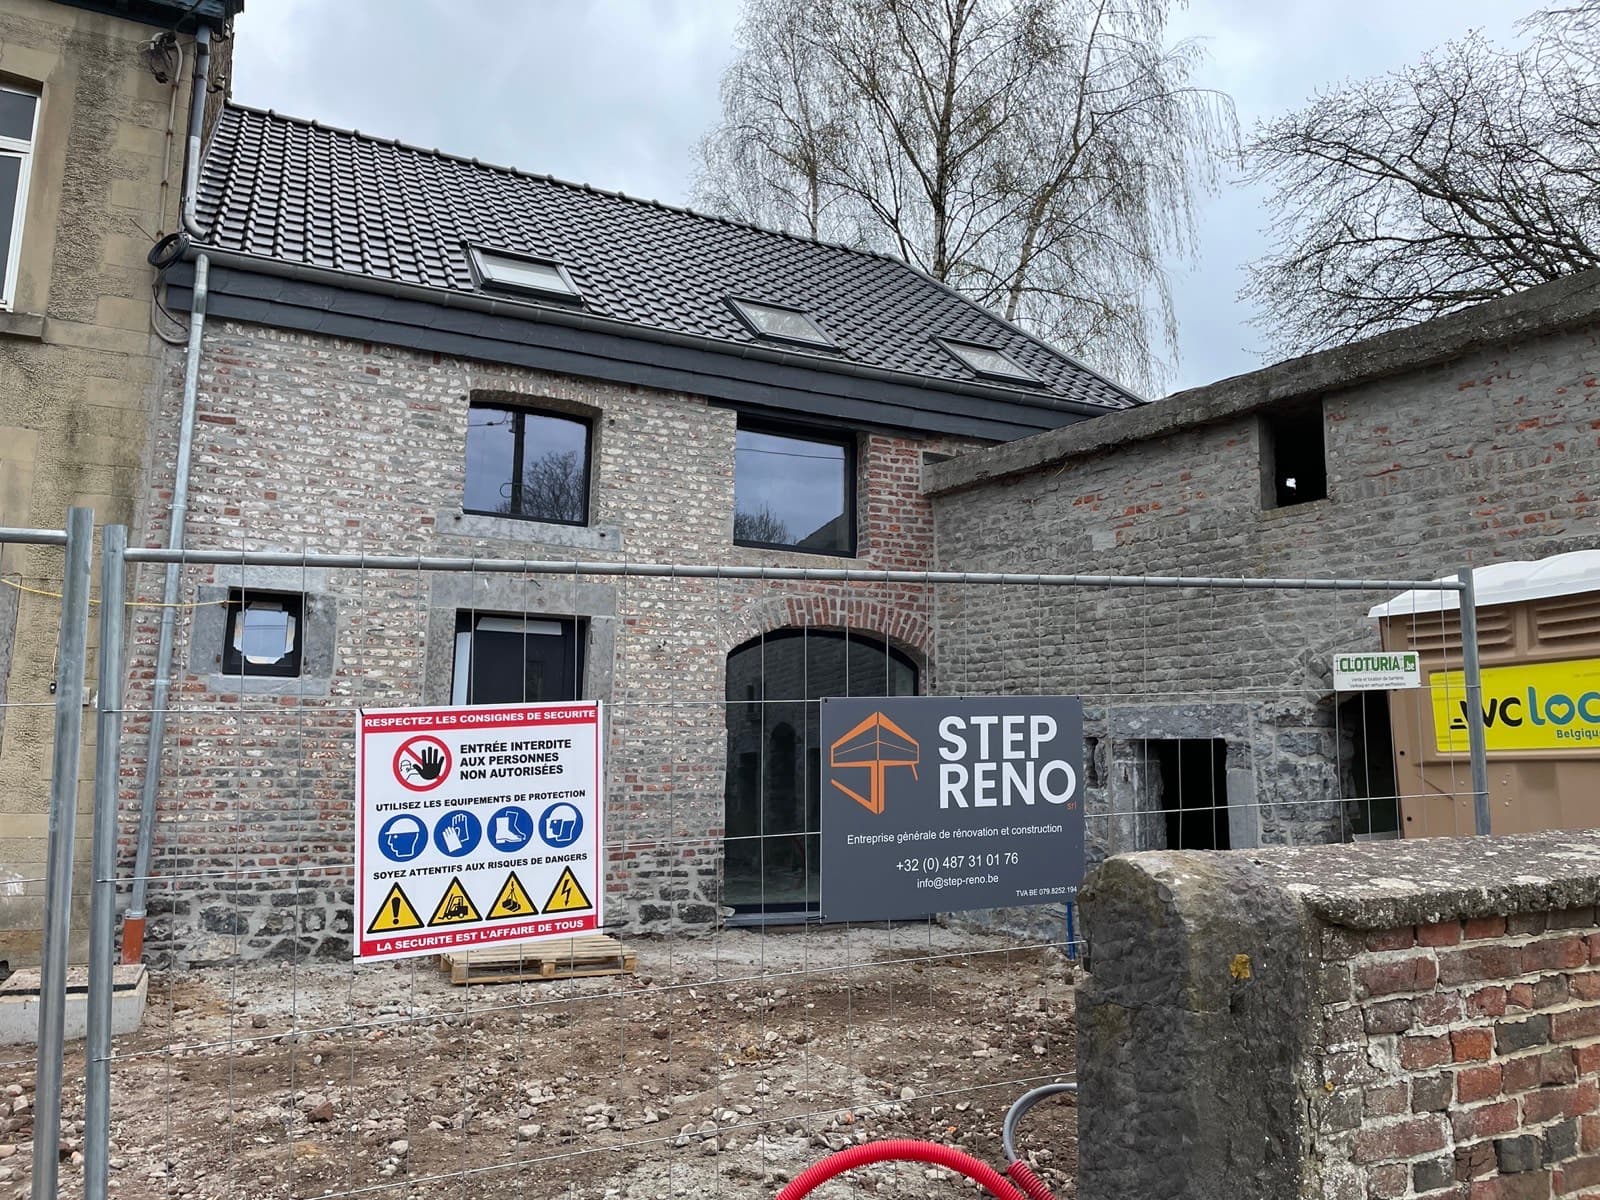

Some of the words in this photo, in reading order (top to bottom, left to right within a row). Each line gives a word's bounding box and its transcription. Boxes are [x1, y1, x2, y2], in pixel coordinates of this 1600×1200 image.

[1339, 656, 1401, 672] CLOTURIA
[365, 716, 433, 728] RESPECTEZ
[435, 714, 457, 725] LES
[459, 712, 524, 724] CONSIGNES
[526, 711, 542, 721] DE
[543, 709, 596, 720] SECURITE
[938, 715, 1058, 761] STEP
[1556, 728, 1600, 741] Belgiqu
[460, 740, 508, 754] ENTRÉE
[510, 739, 572, 751] INTERDITE
[460, 756, 485, 767] AUX
[488, 752, 559, 766] PERSONNES
[460, 769, 487, 780] NON
[490, 764, 563, 778] AUTORISÉES
[939, 760, 1077, 809] RENO
[376, 802, 421, 812] UTILISEZ
[423, 799, 442, 809] LES
[444, 794, 512, 807] EQUIPEMENTS
[514, 792, 527, 802] DE
[528, 789, 586, 801] PROTECTION
[847, 833, 895, 846] Entreprise
[896, 830, 937, 844] générale
[939, 829, 951, 839] de
[952, 826, 999, 839] rénovation
[1000, 826, 1010, 836] et
[1011, 824, 1062, 836] construction
[373, 870, 407, 880] SOYEZ
[409, 864, 463, 877] ATTENTIFS
[465, 862, 485, 872] AUX
[487, 858, 528, 870] RISQUES
[530, 856, 543, 866] DE
[545, 852, 588, 864] DANGERS
[896, 858, 919, 872] +32
[922, 857, 940, 873] (0)
[942, 855, 965, 869] 487
[968, 854, 982, 867] 31
[986, 853, 1000, 866] 01
[1004, 851, 1019, 864] 76
[916, 874, 999, 890] info@step-reno.be
[1015, 889, 1028, 897] TVA
[1029, 888, 1038, 896] BE
[376, 943, 392, 952] LA
[394, 934, 452, 950] SECURITE
[456, 932, 477, 942] EST
[480, 926, 535, 939] L'AFFAIRE
[538, 923, 552, 933] DE
[554, 919, 584, 930] TOUS
